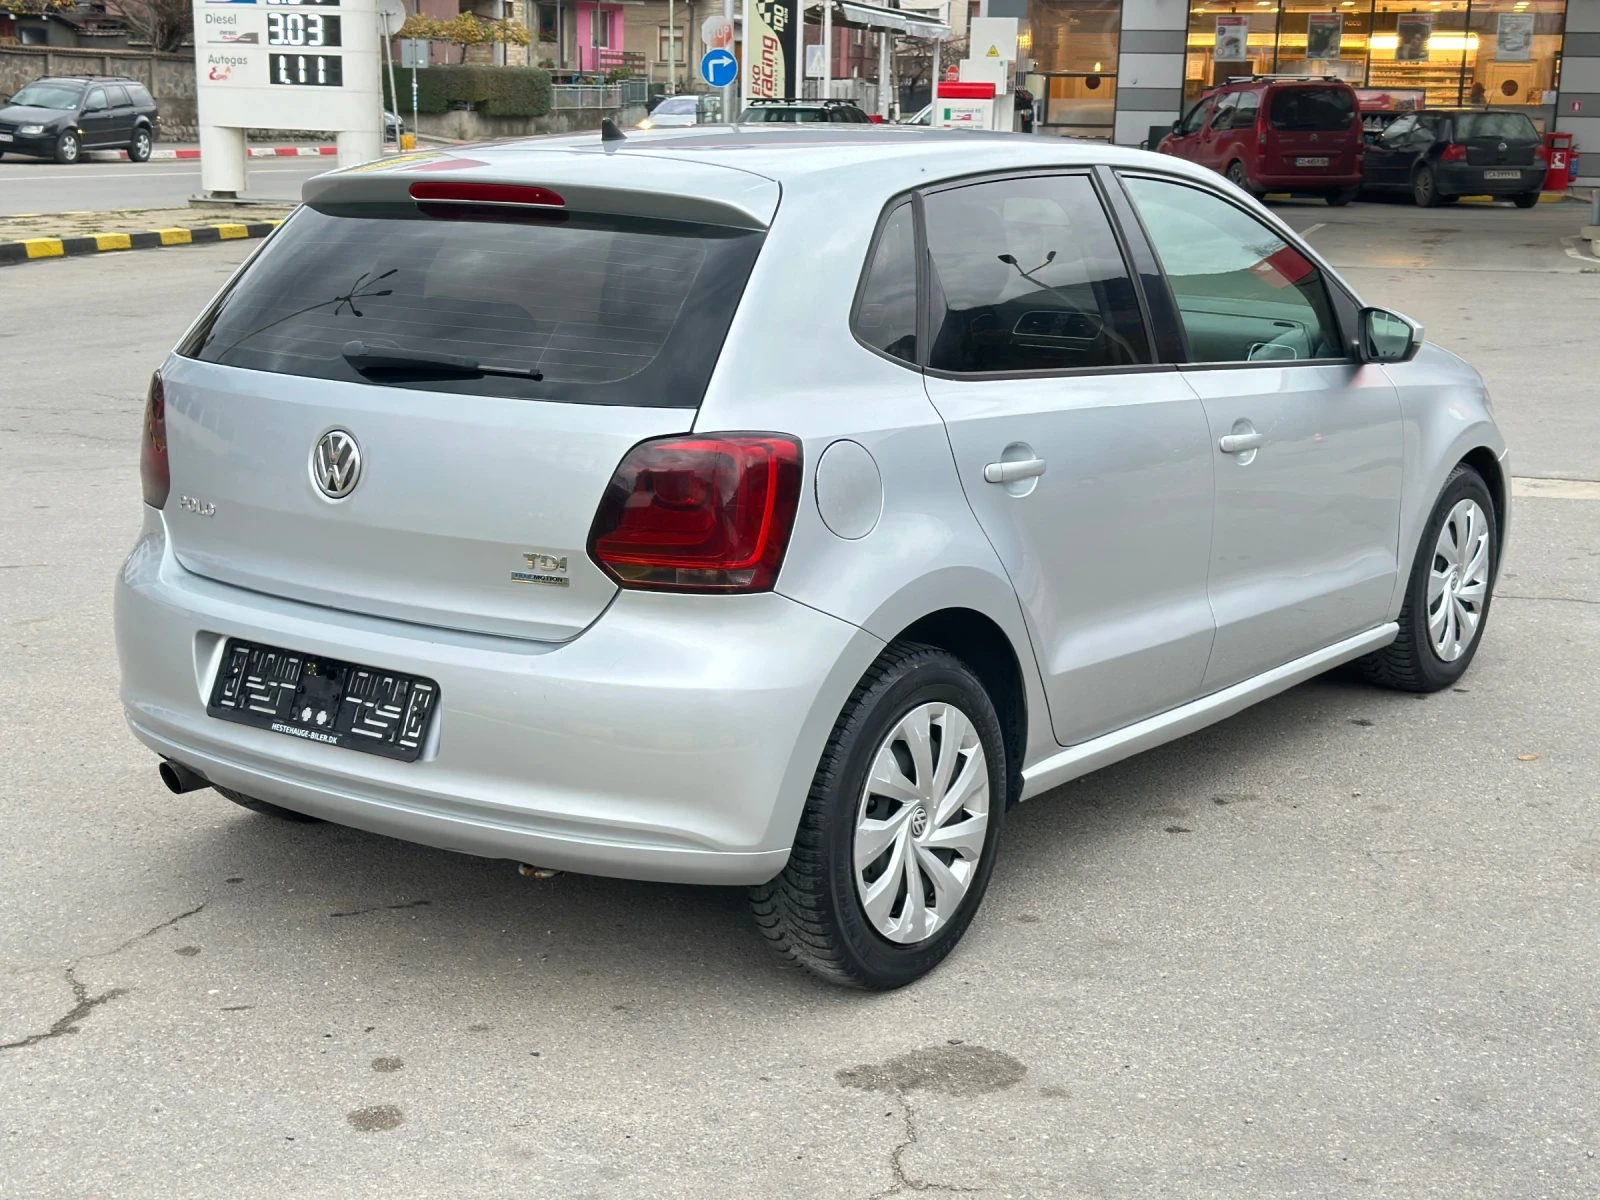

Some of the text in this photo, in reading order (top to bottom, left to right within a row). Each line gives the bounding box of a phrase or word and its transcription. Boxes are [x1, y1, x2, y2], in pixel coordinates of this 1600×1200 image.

[205, 13, 237, 25] Diesel
[268, 13, 324, 46] 3.03
[773, 4, 784, 32] 100
[207, 54, 248, 67] Autogas
[278, 54, 326, 84] 1.11
[761, 35, 778, 98] racing
[752, 64, 761, 96] EKO
[180, 493, 216, 517] POLO
[523, 551, 568, 573] TDI
[271, 723, 338, 744] HESTEHAUGE-BILER.DK
